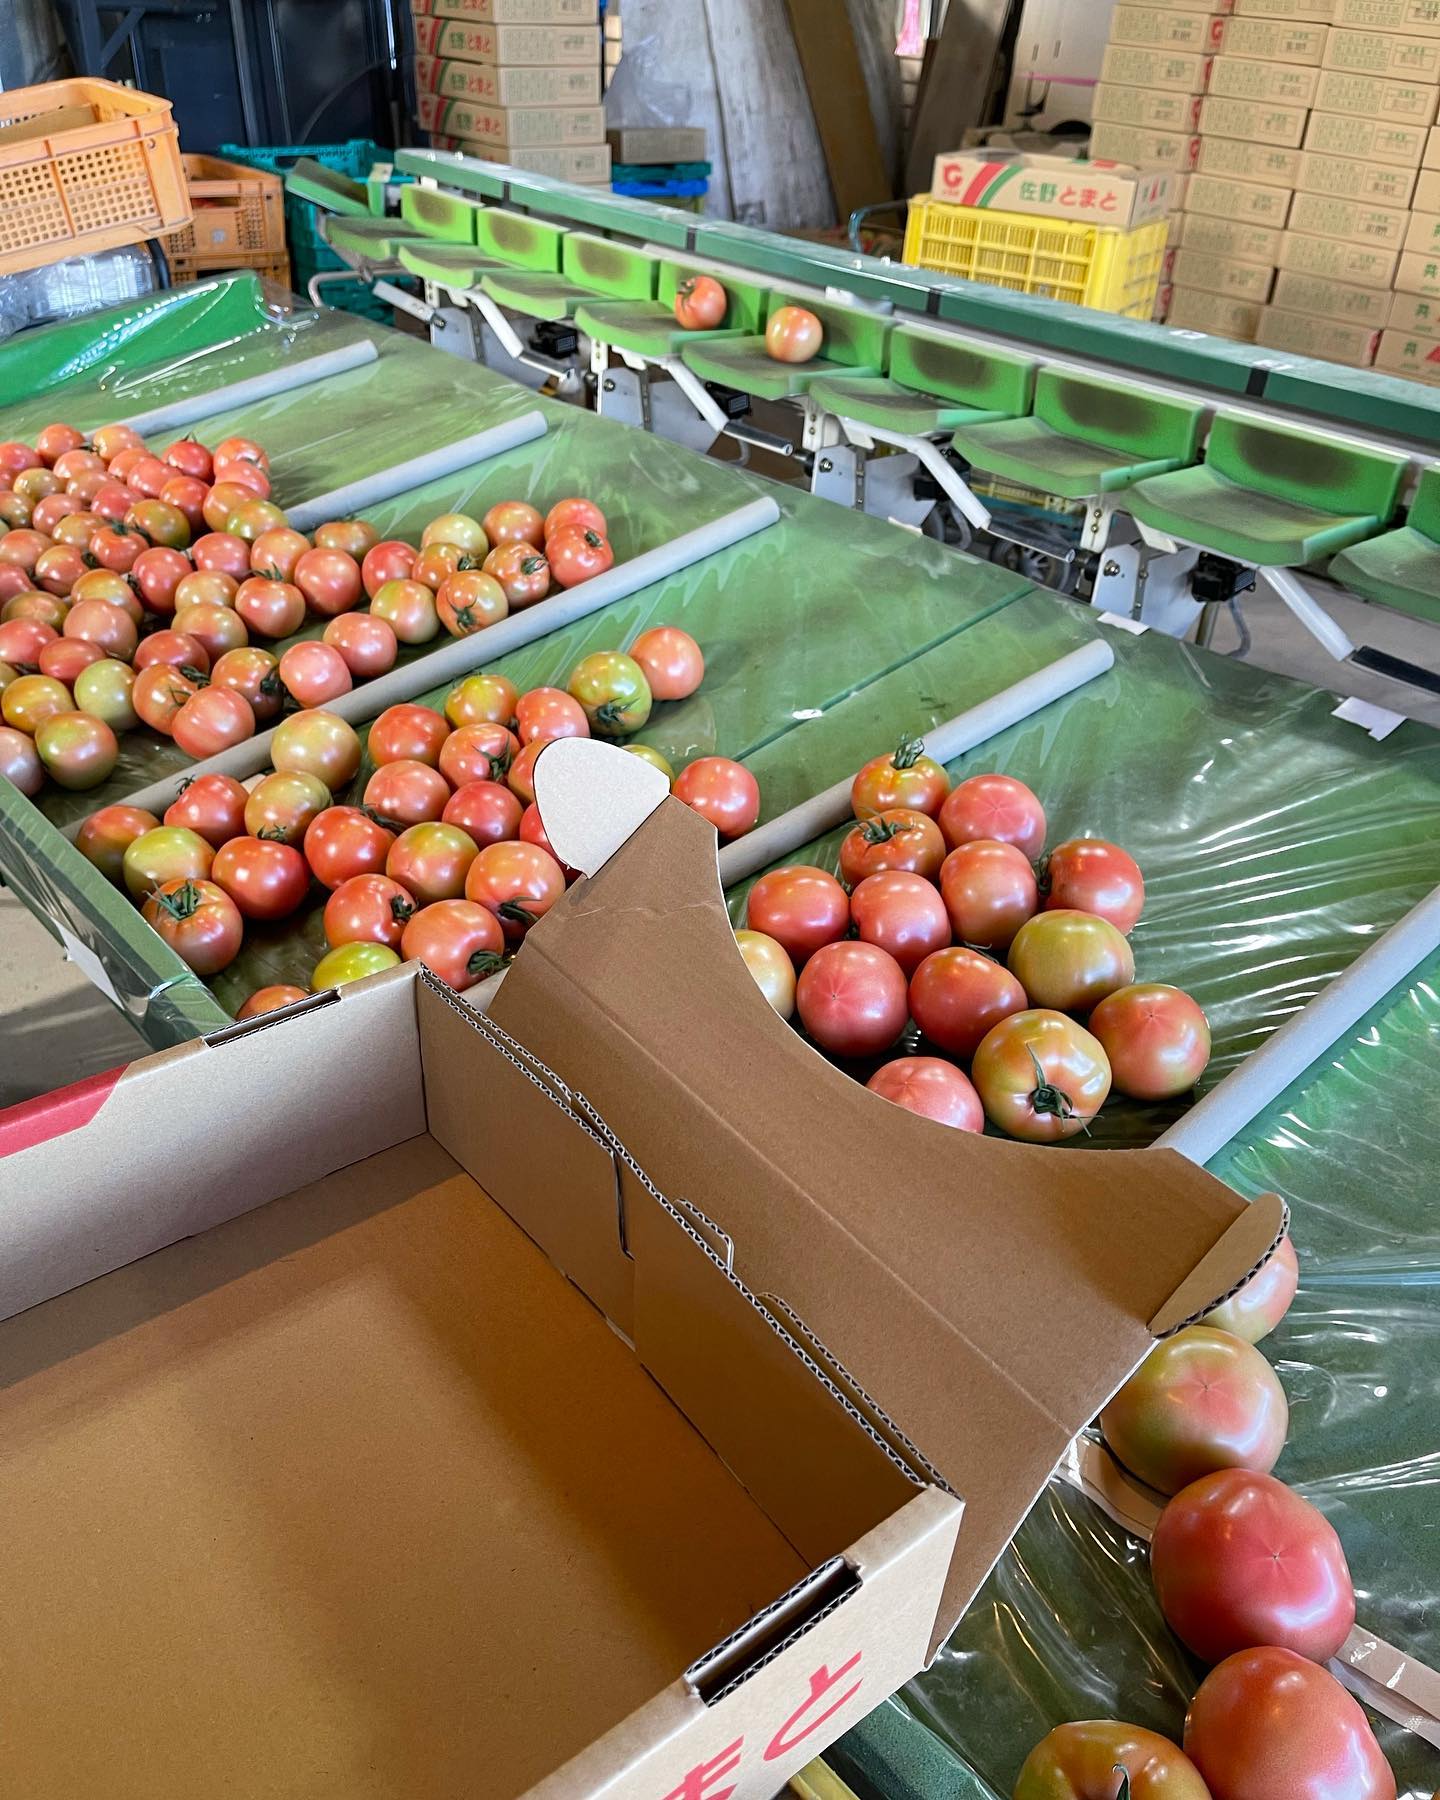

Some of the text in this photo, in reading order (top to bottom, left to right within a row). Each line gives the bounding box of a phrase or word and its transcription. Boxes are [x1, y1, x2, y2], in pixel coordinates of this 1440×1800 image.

[1019, 180, 1118, 212] 佐野とまと
